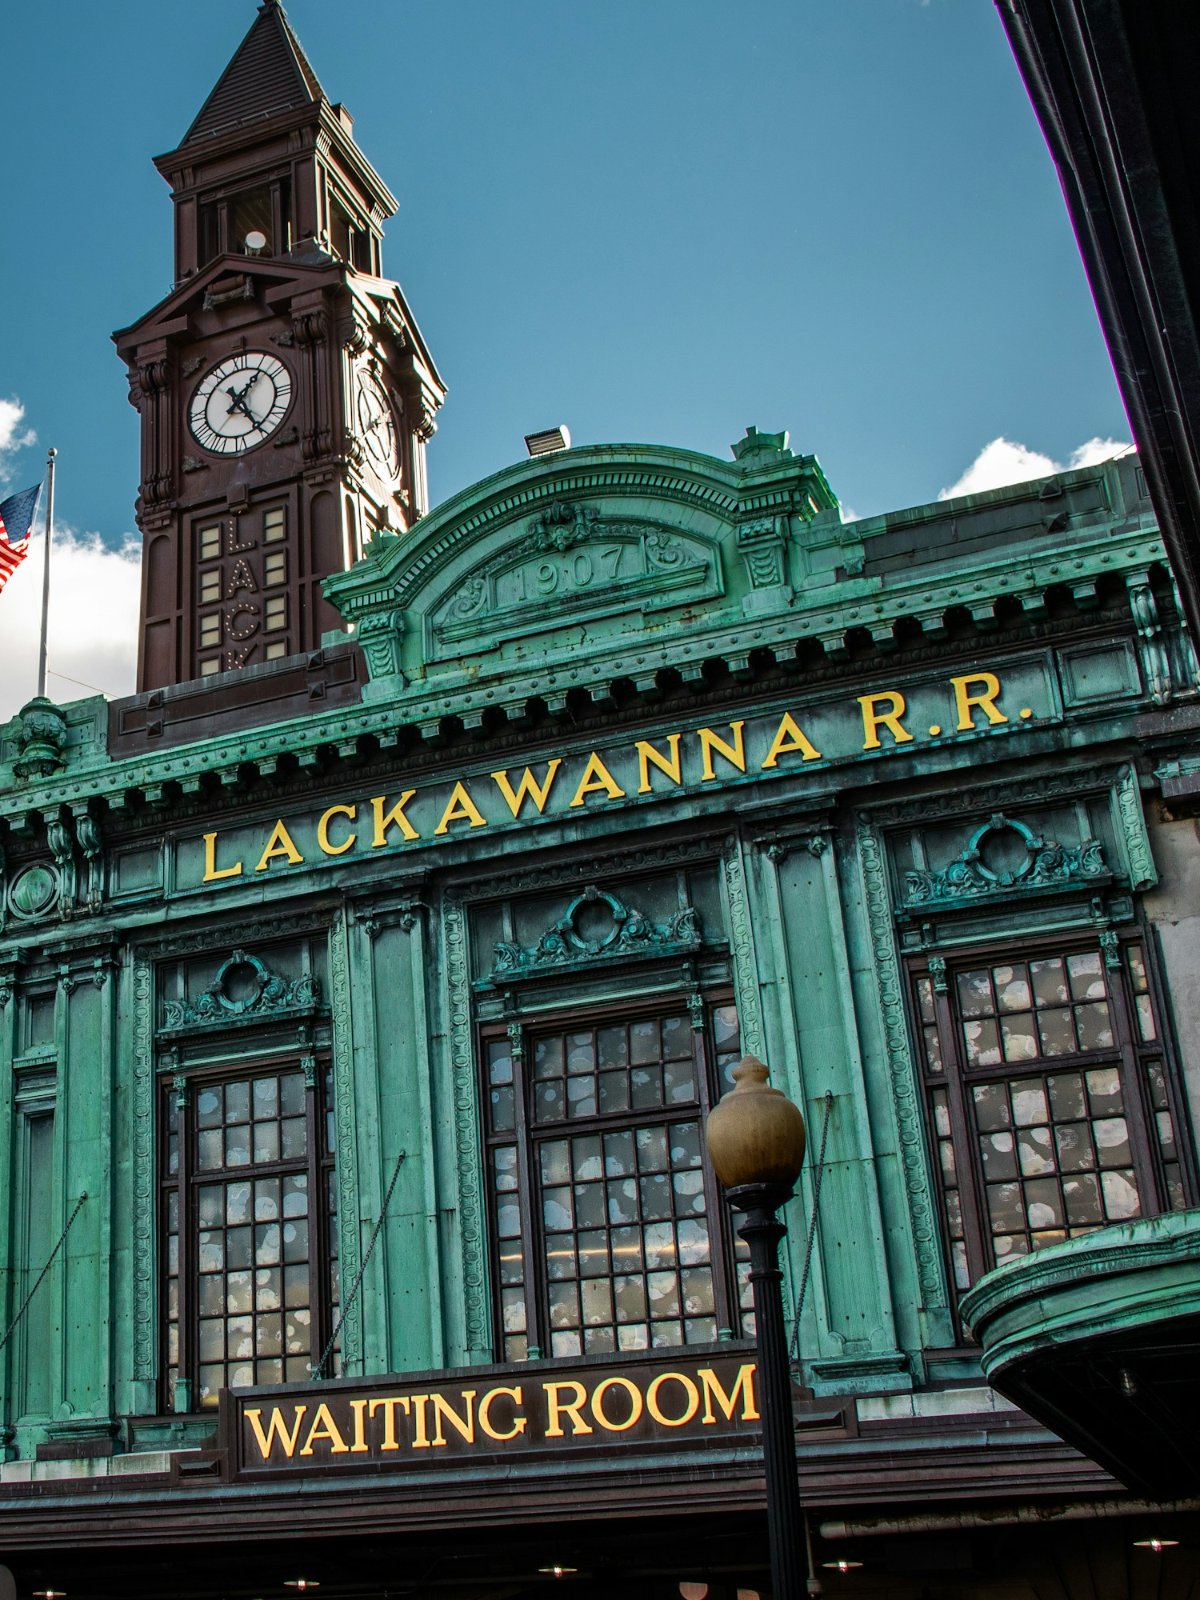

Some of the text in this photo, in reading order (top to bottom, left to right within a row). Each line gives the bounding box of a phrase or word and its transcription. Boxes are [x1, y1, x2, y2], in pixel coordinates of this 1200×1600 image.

[515, 544, 625, 602] 1907
[203, 711, 821, 882] LACKAWANNA
[244, 1364, 761, 1459] WAITING ROOM
